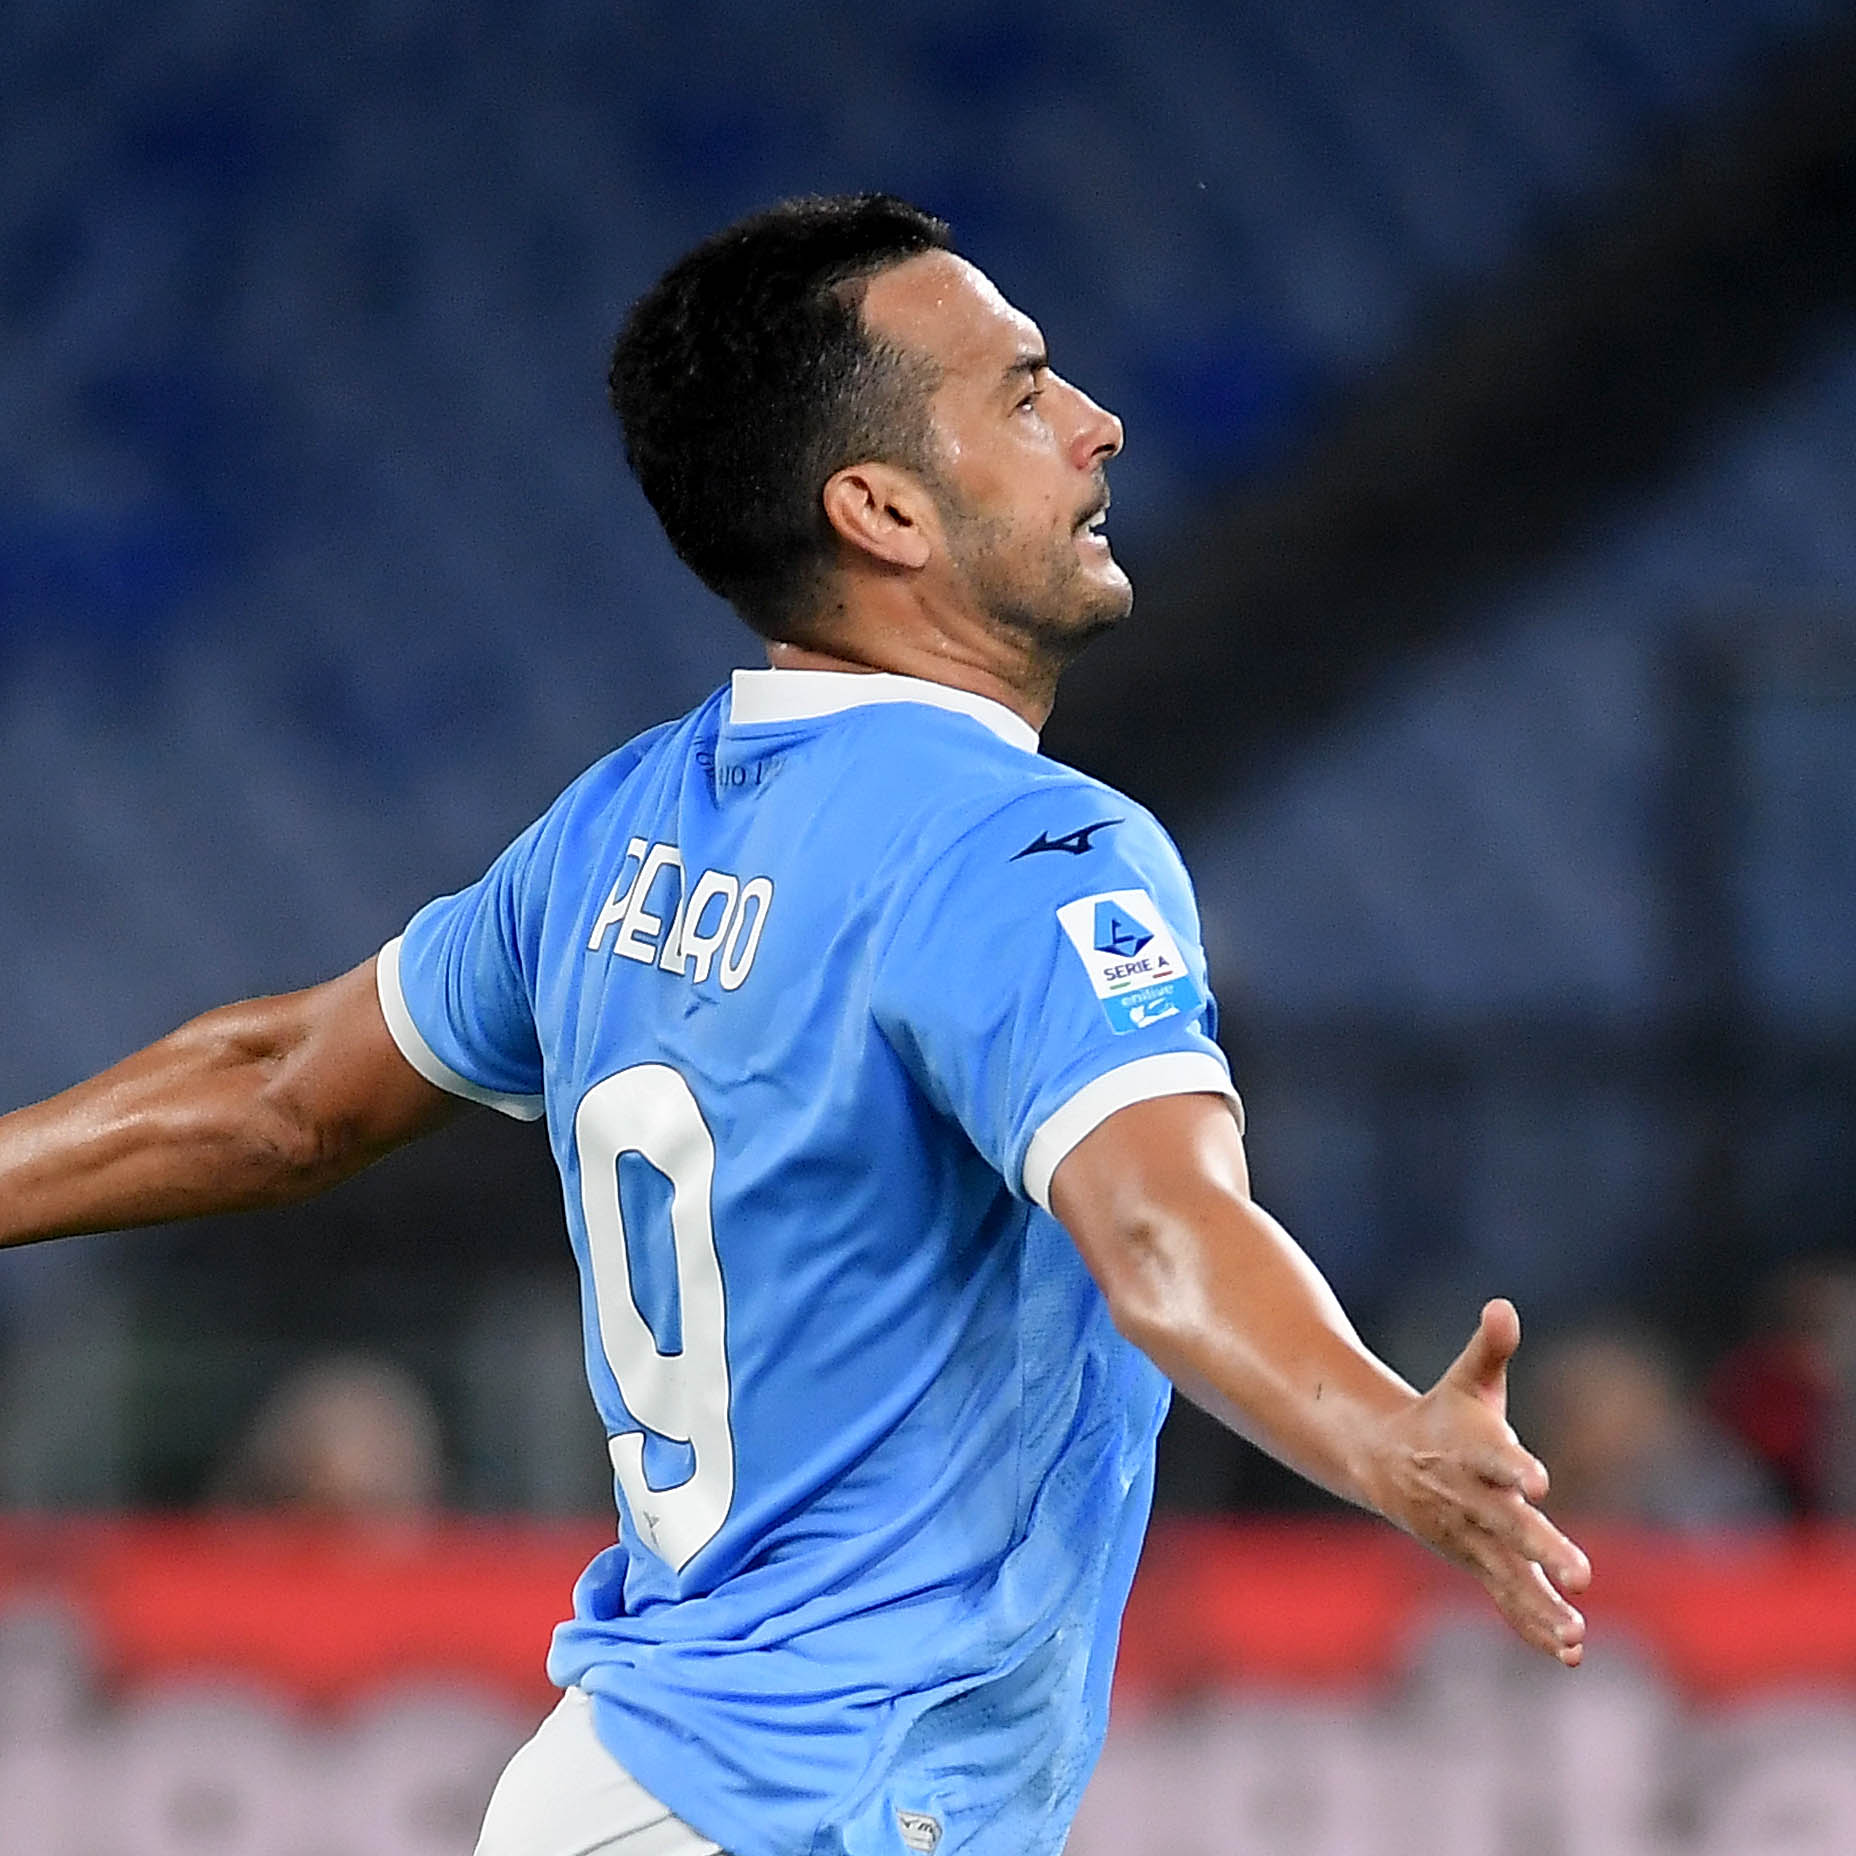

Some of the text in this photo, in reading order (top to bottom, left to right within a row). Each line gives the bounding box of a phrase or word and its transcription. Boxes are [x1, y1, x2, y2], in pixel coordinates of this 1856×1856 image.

[1103, 955, 1170, 981] SERIE A
[575, 1062, 735, 1575] 9
